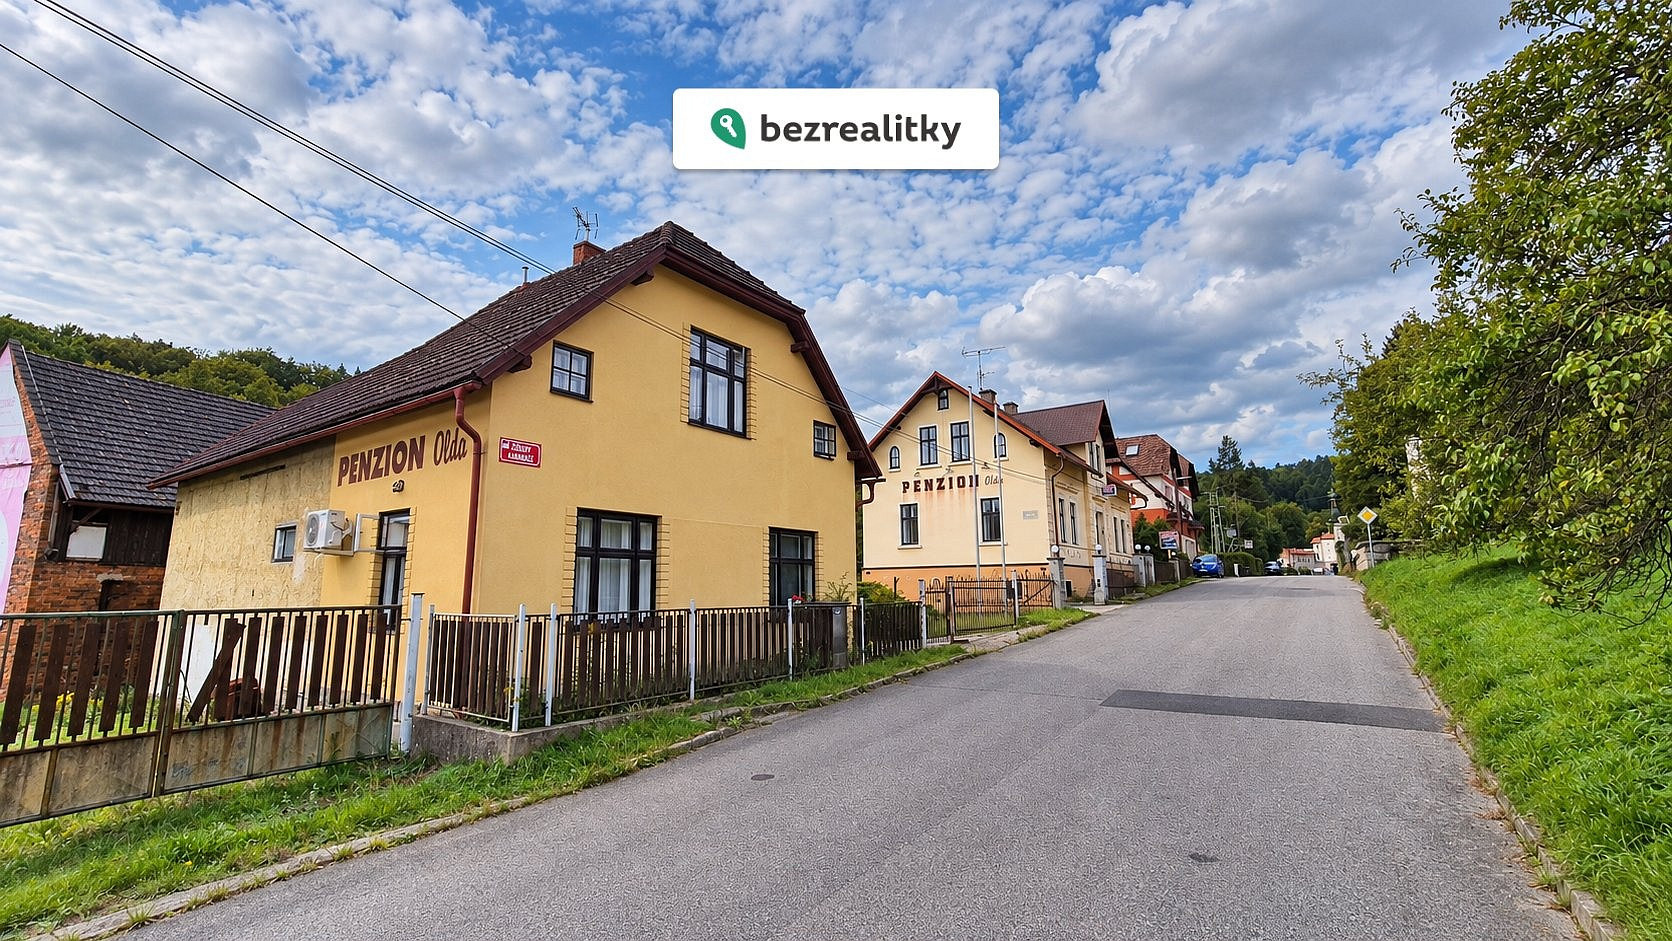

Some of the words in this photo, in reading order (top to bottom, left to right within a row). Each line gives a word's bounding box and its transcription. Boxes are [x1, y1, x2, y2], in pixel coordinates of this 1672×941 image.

[337, 434, 426, 487] PENZION
[433, 427, 468, 466] Olda
[902, 474, 980, 494] PENZION
